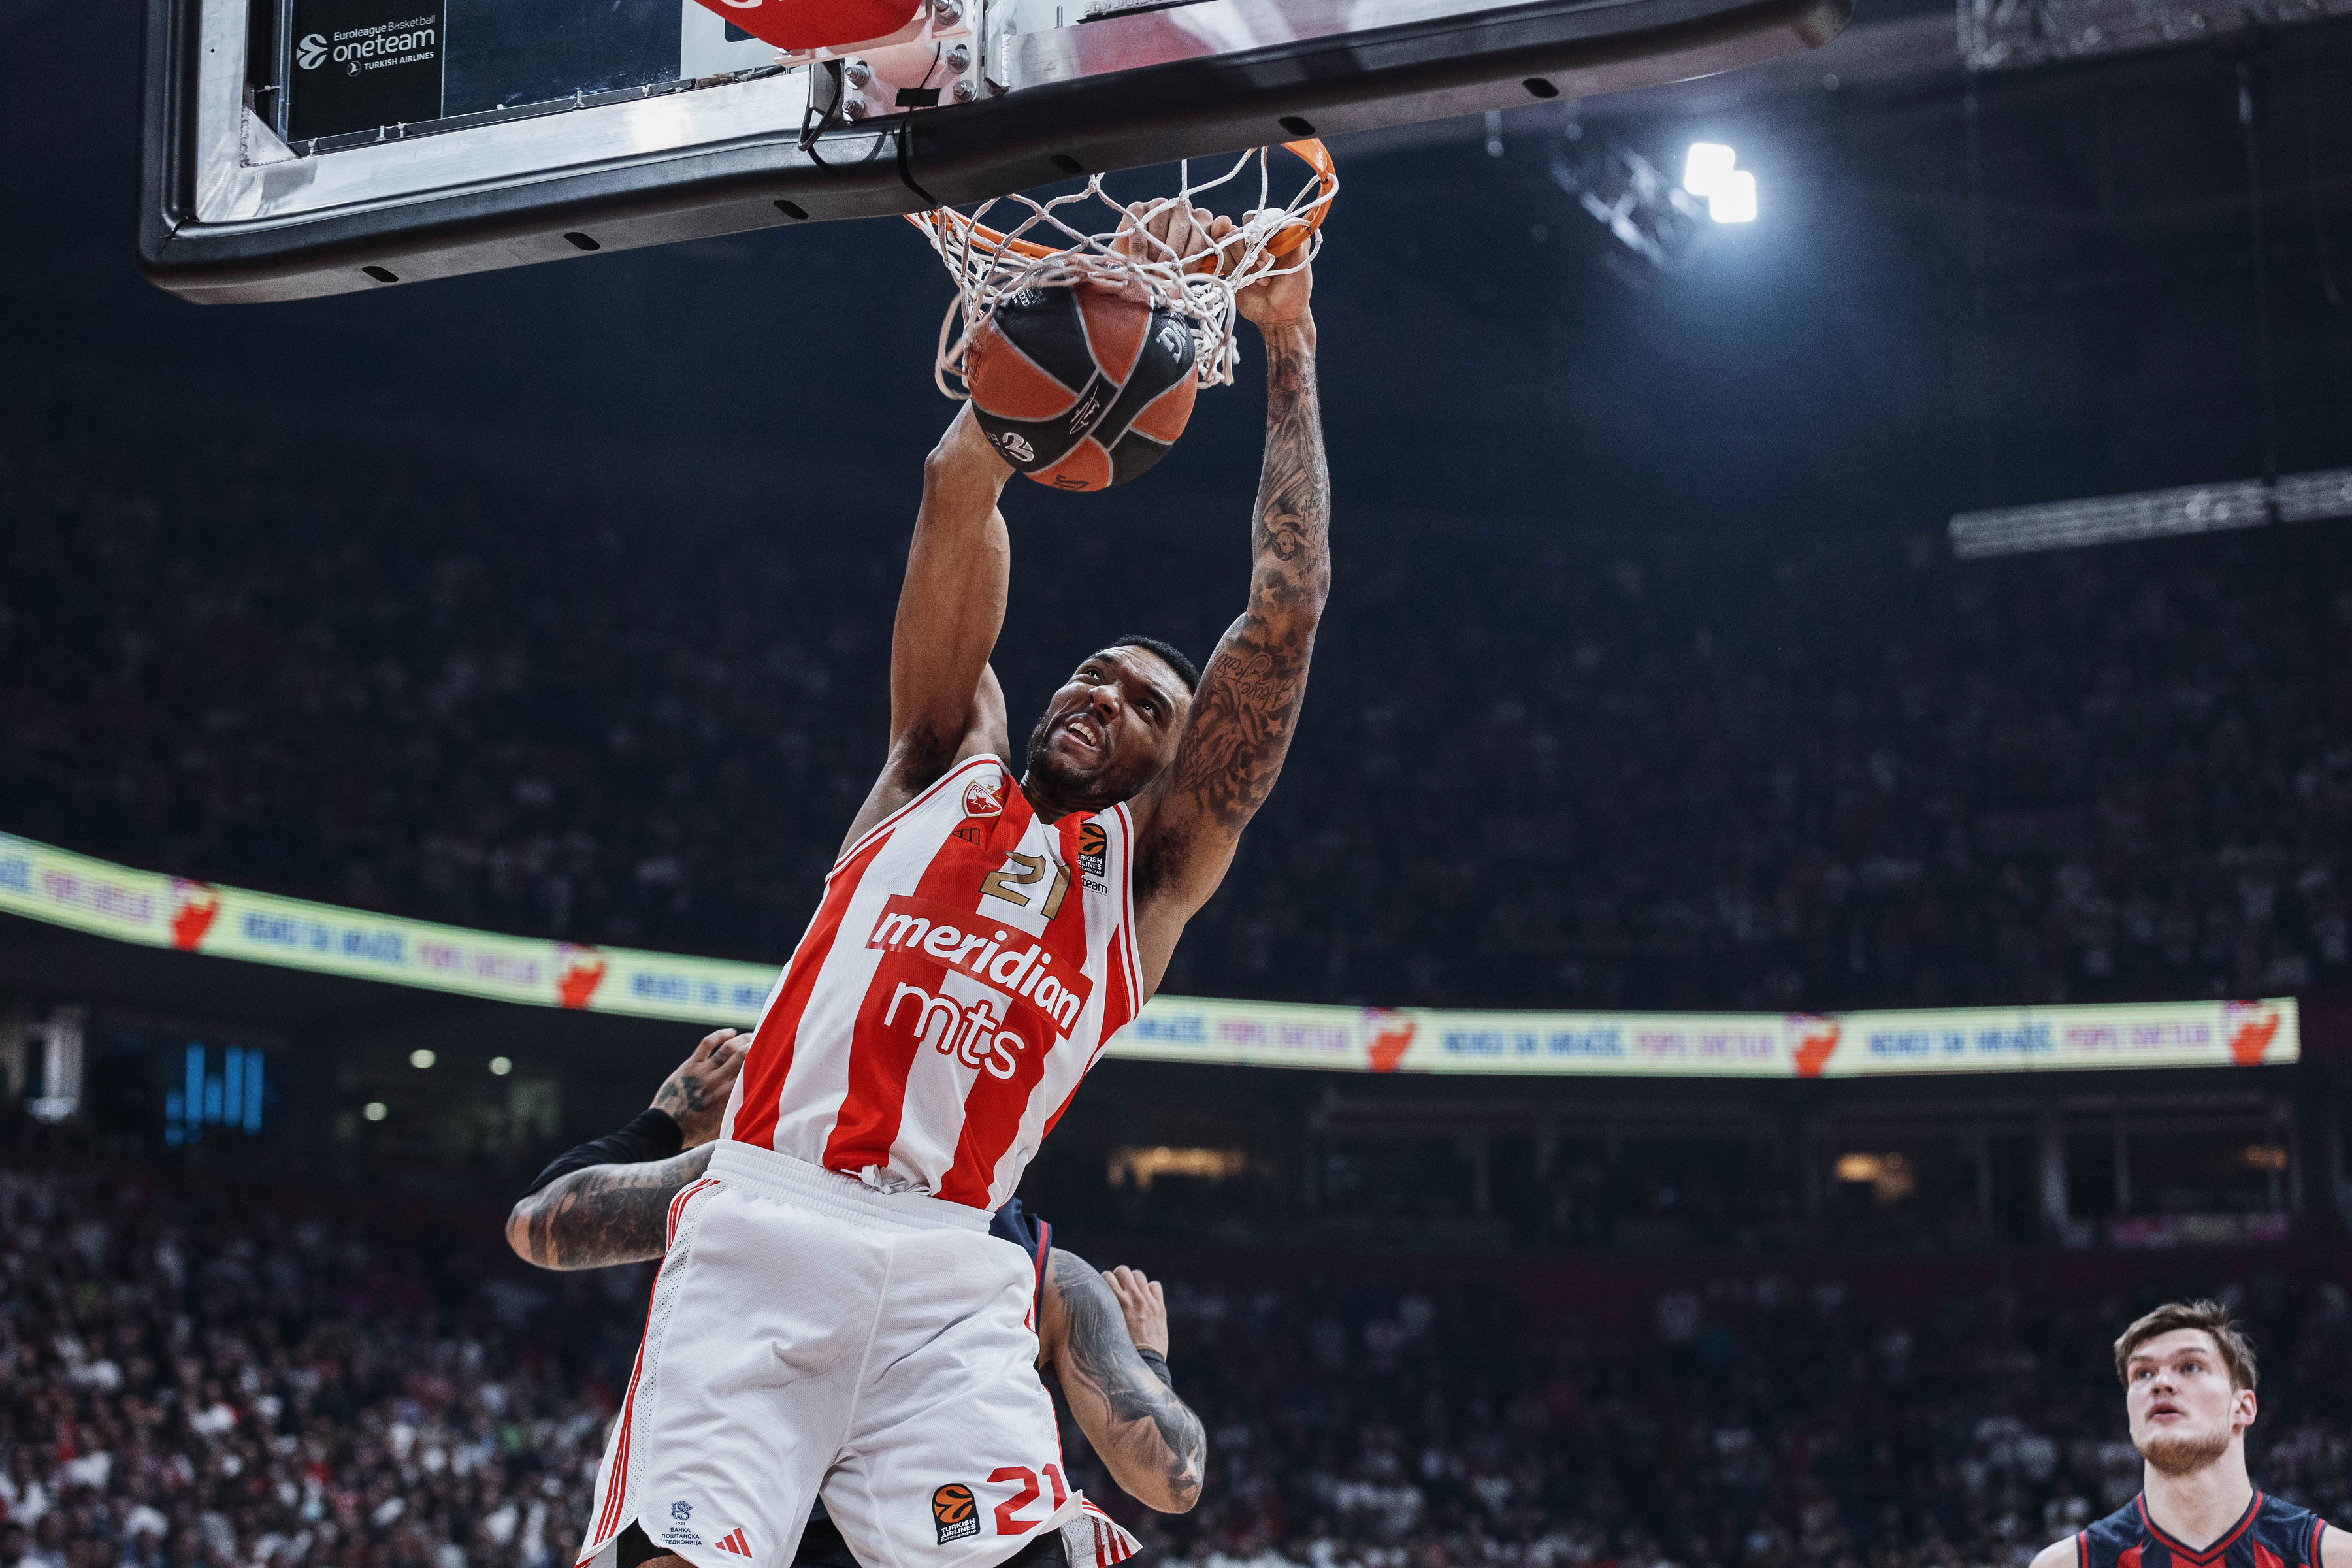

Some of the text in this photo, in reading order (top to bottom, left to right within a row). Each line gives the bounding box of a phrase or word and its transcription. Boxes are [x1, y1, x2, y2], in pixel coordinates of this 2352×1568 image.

[334, 14, 436, 41] Euroleague Basketball
[333, 29, 435, 62] oneteam
[364, 51, 434, 70] TURKISH AIRLINES
[978, 851, 1071, 921] 21
[871, 913, 1081, 1030] meridian
[883, 981, 1026, 1079] mts
[987, 1463, 1068, 1535] 21
[941, 1518, 975, 1533] TURKISH
[941, 1524, 976, 1539] AIRLINES
[941, 1529, 977, 1542] EuroLeague
